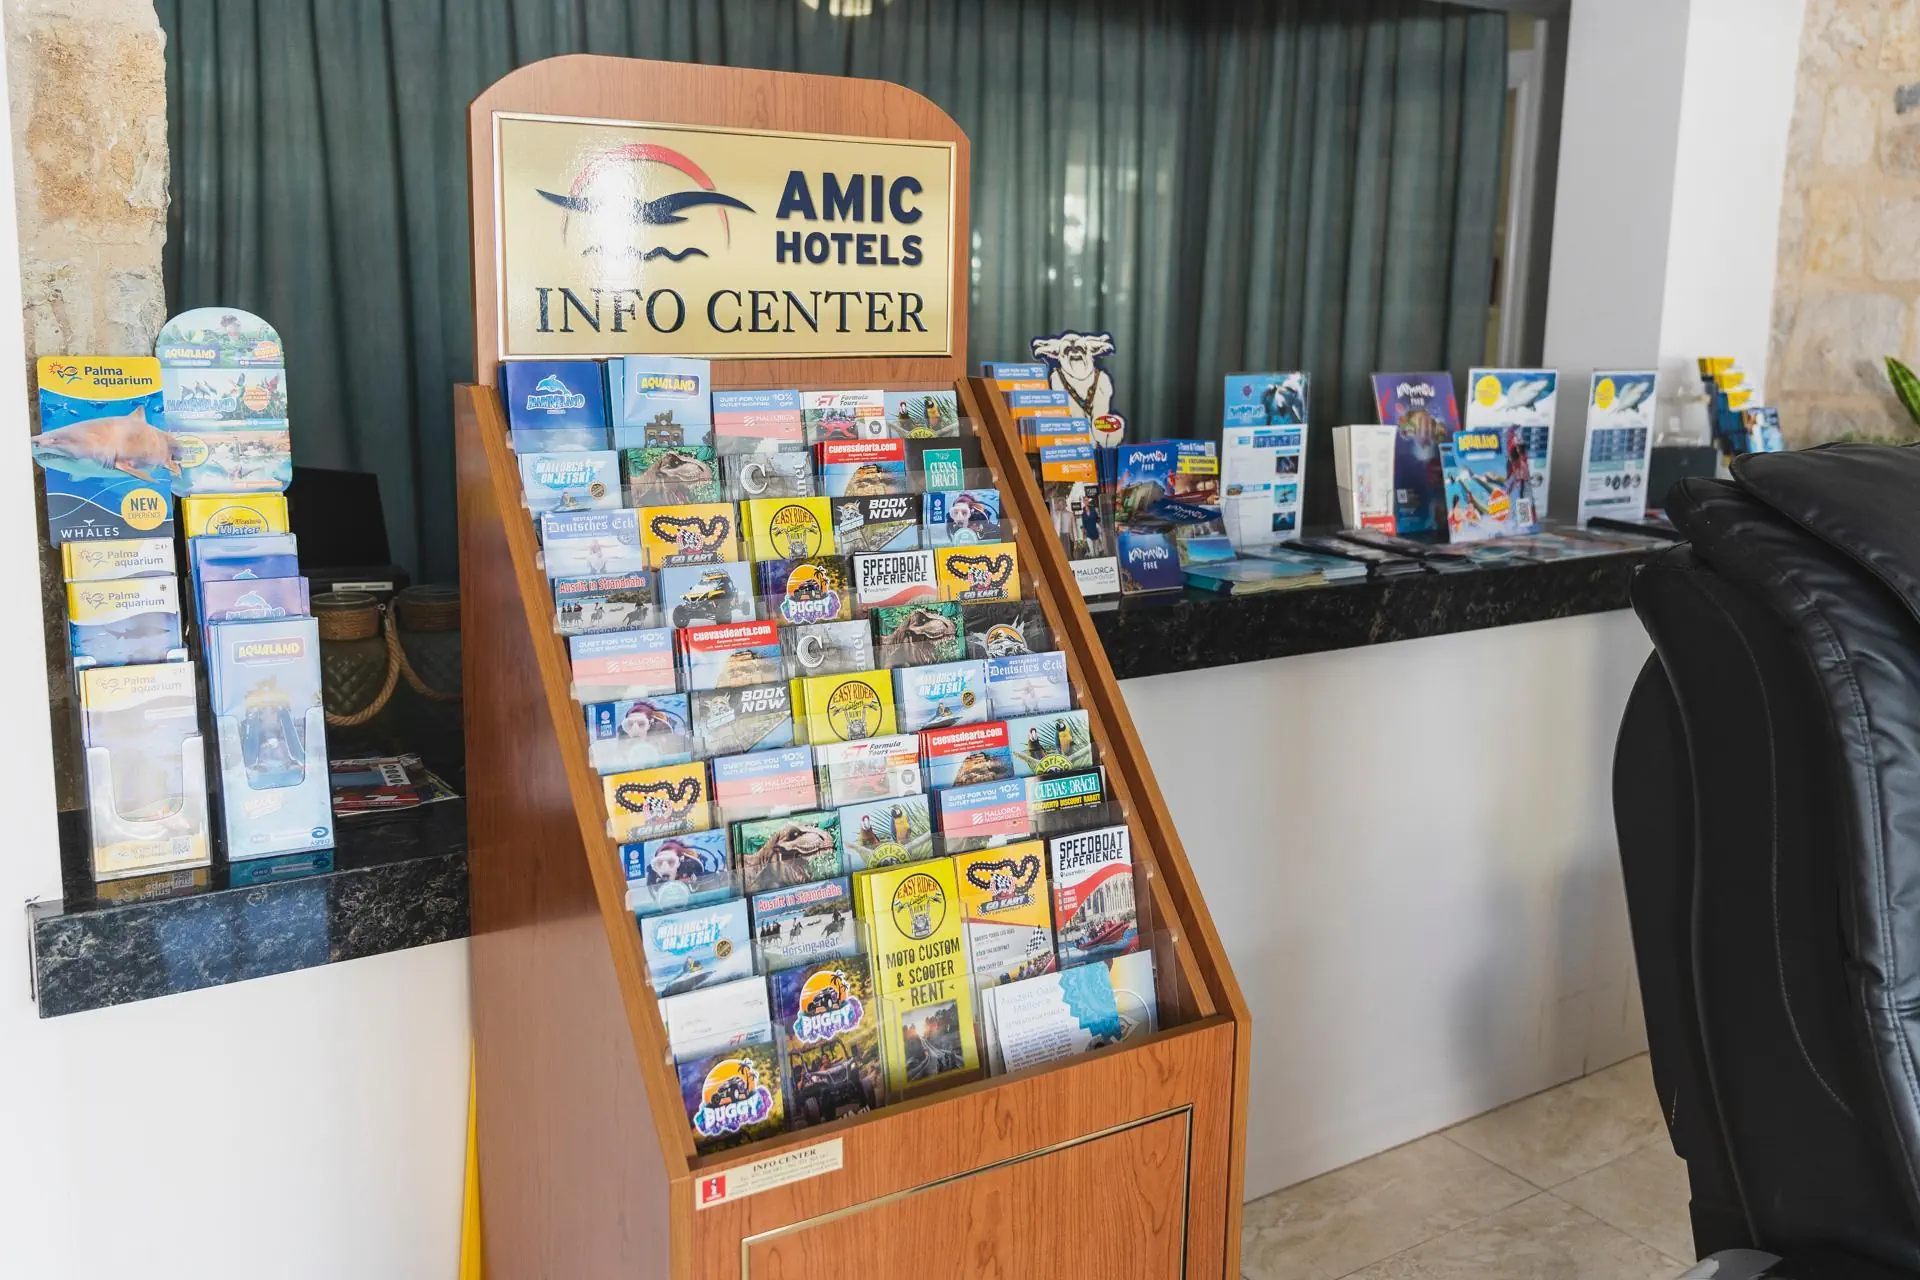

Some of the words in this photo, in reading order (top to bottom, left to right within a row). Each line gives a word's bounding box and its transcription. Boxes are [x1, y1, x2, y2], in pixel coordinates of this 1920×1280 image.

[775, 170, 924, 225] AMIC
[775, 231, 924, 267] HOTELS
[535, 287, 686, 334] INFO
[707, 289, 928, 334] CENTER
[84, 366, 123, 376] Palma
[93, 376, 153, 388] aquarium
[1129, 450, 1168, 465] KATMANDU
[930, 461, 958, 473] CUEVAS
[932, 474, 958, 488] DRACH
[130, 498, 158, 511] NEW
[869, 497, 907, 509] BOOK
[128, 511, 161, 519] EXPERIENCE
[775, 508, 793, 524] EASY
[794, 508, 814, 524] RIDER
[869, 507, 908, 520] NOW
[60, 527, 120, 538] WHALES
[548, 520, 608, 533] Deutsches
[612, 518, 634, 530] Eck
[107, 550, 139, 559] Palma
[114, 556, 164, 567] aquarium
[687, 554, 714, 562] KART
[1128, 546, 1169, 563] KATMANDU
[863, 556, 927, 576] SPEEDBOAT
[1076, 566, 1115, 576] MALLORCA
[863, 572, 928, 586] EXPERIENCE
[108, 592, 140, 600] Palma
[977, 589, 999, 598] KART
[115, 598, 165, 609] aquarium
[790, 600, 830, 616] BUGGY
[694, 626, 772, 641] cuevasdearta.com
[990, 663, 1039, 677] Deutsches
[1042, 660, 1062, 671] Eck
[741, 687, 786, 702] BOOK
[833, 684, 854, 704] EASY
[853, 684, 874, 700] RIDER
[741, 698, 786, 713] NOW
[932, 728, 1002, 746] cuevasdearta.com
[870, 742, 901, 750] Formula
[782, 752, 804, 762] 10%
[1000, 784, 1020, 792] 10%
[1034, 782, 1068, 800] CUEVAS
[1060, 831, 1123, 860] SPEEDBOAT
[1060, 848, 1123, 870] EXPERIENCE
[897, 882, 916, 900] EASY
[916, 876, 938, 894] RIDER
[1001, 896, 1024, 908] KART
[886, 948, 916, 969] MOTO
[918, 937, 960, 962] CUSTOM
[896, 972, 904, 988] &
[908, 960, 954, 986] SCOOTER
[910, 980, 945, 1007] RENT
[803, 1006, 852, 1034] BUGGY
[704, 1096, 758, 1128] BUGGY
[753, 1160, 777, 1172] INFO
[778, 1148, 816, 1166] CENTER
